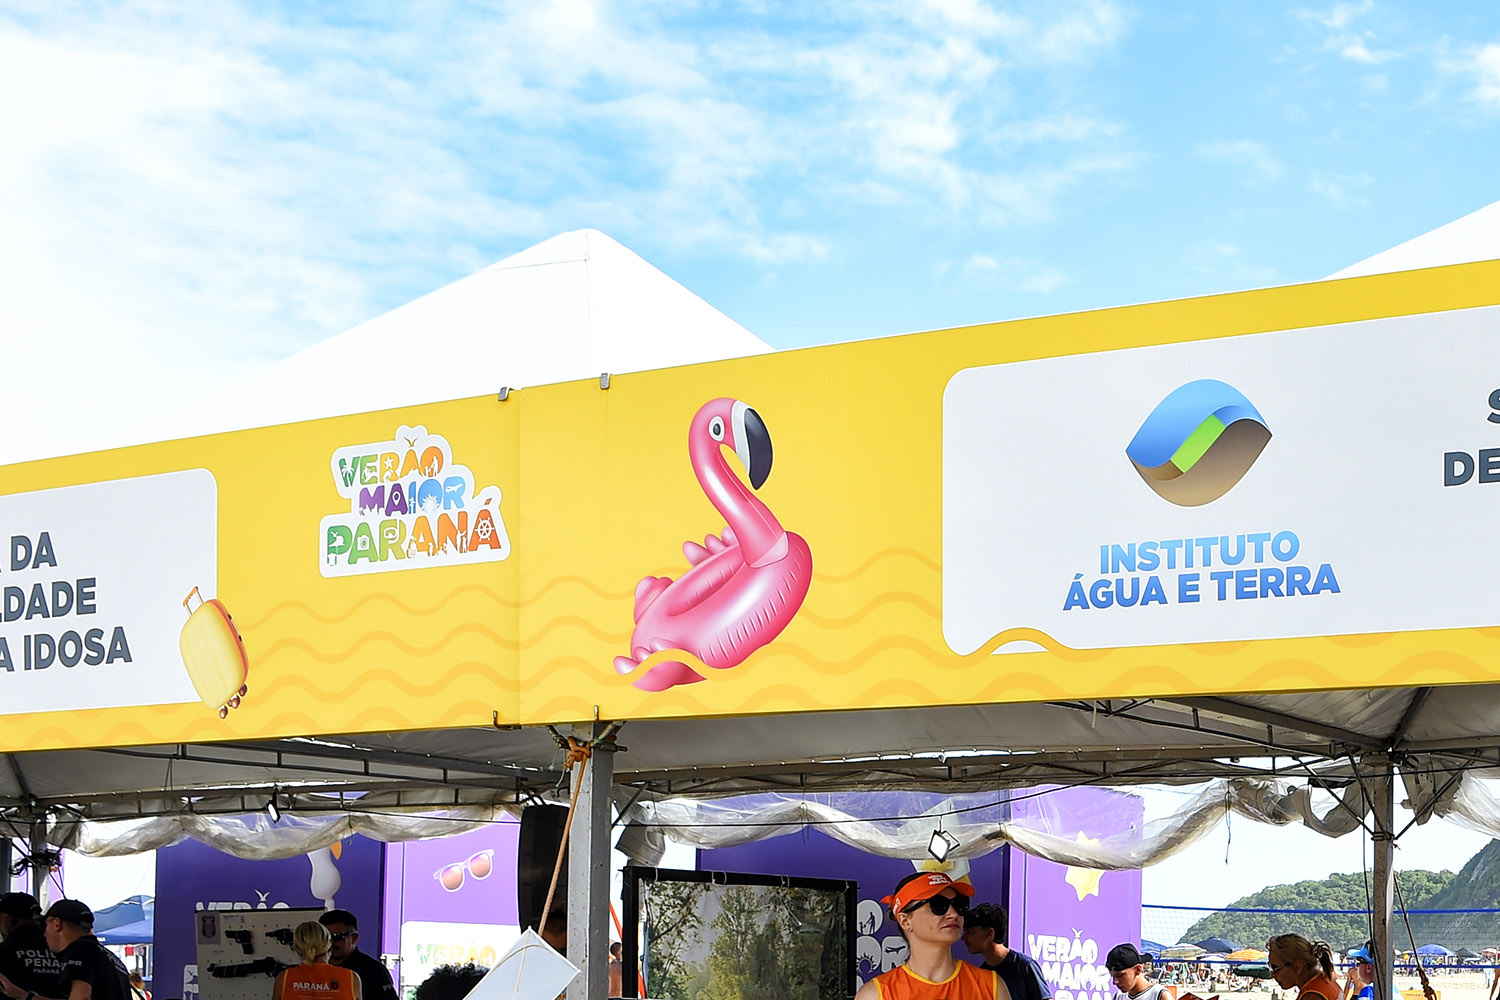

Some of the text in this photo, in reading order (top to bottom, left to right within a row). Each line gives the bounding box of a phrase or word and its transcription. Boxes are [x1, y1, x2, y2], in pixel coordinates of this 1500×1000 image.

[338, 436, 444, 488] VERÃO
[358, 475, 466, 517] MAIOR
[10, 531, 57, 571] DA
[326, 497, 502, 567] PARANÁ
[1099, 530, 1301, 576] INSTITUTO
[0, 577, 97, 623] DADE
[1062, 565, 1342, 613] ÁGUA E TERRA
[23, 626, 133, 671] IDOSA
[25, 958, 61, 967] PENA
[1027, 926, 1099, 964] VERÃO
[292, 979, 330, 992] PARANÁ
[1041, 961, 1112, 991] MAIOR
